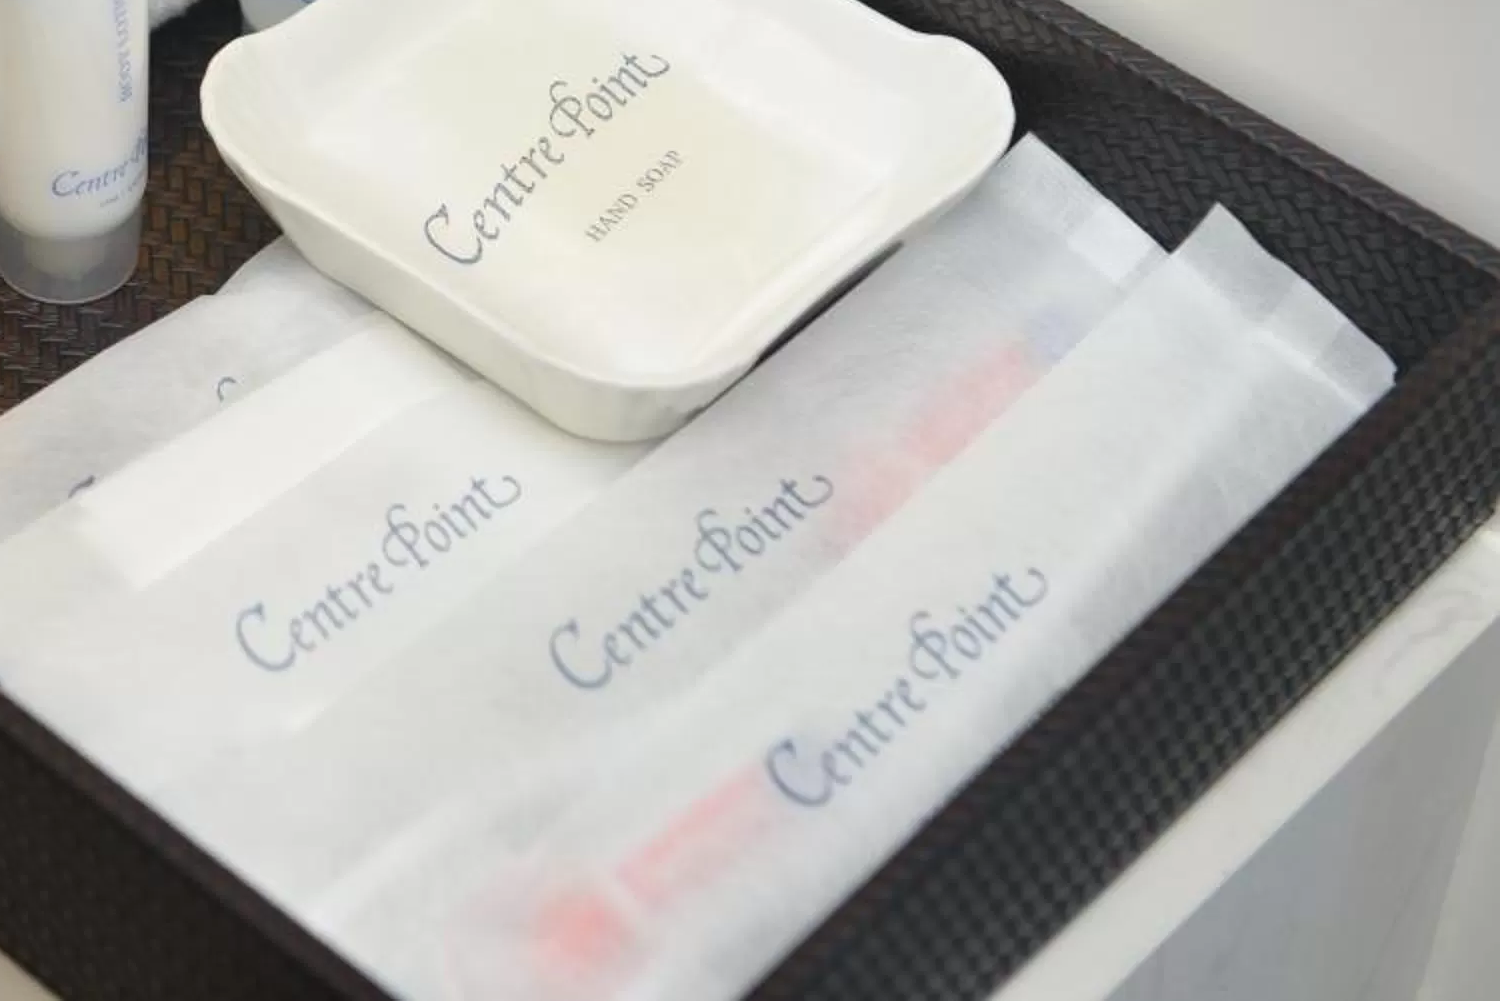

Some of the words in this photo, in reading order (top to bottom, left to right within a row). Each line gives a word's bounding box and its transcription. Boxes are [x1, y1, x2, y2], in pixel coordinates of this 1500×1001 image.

[117, 51, 132, 103] BODY
[423, 136, 564, 265] Centre
[549, 53, 671, 137] Point
[51, 160, 128, 197] Centre
[584, 193, 638, 242] HAND
[636, 149, 685, 193] SOAP
[235, 561, 394, 672] Centre
[381, 475, 522, 569] Point
[548, 566, 710, 690] Centre
[694, 474, 834, 573] Point
[764, 677, 927, 808] Centre
[909, 566, 1049, 681] Point
